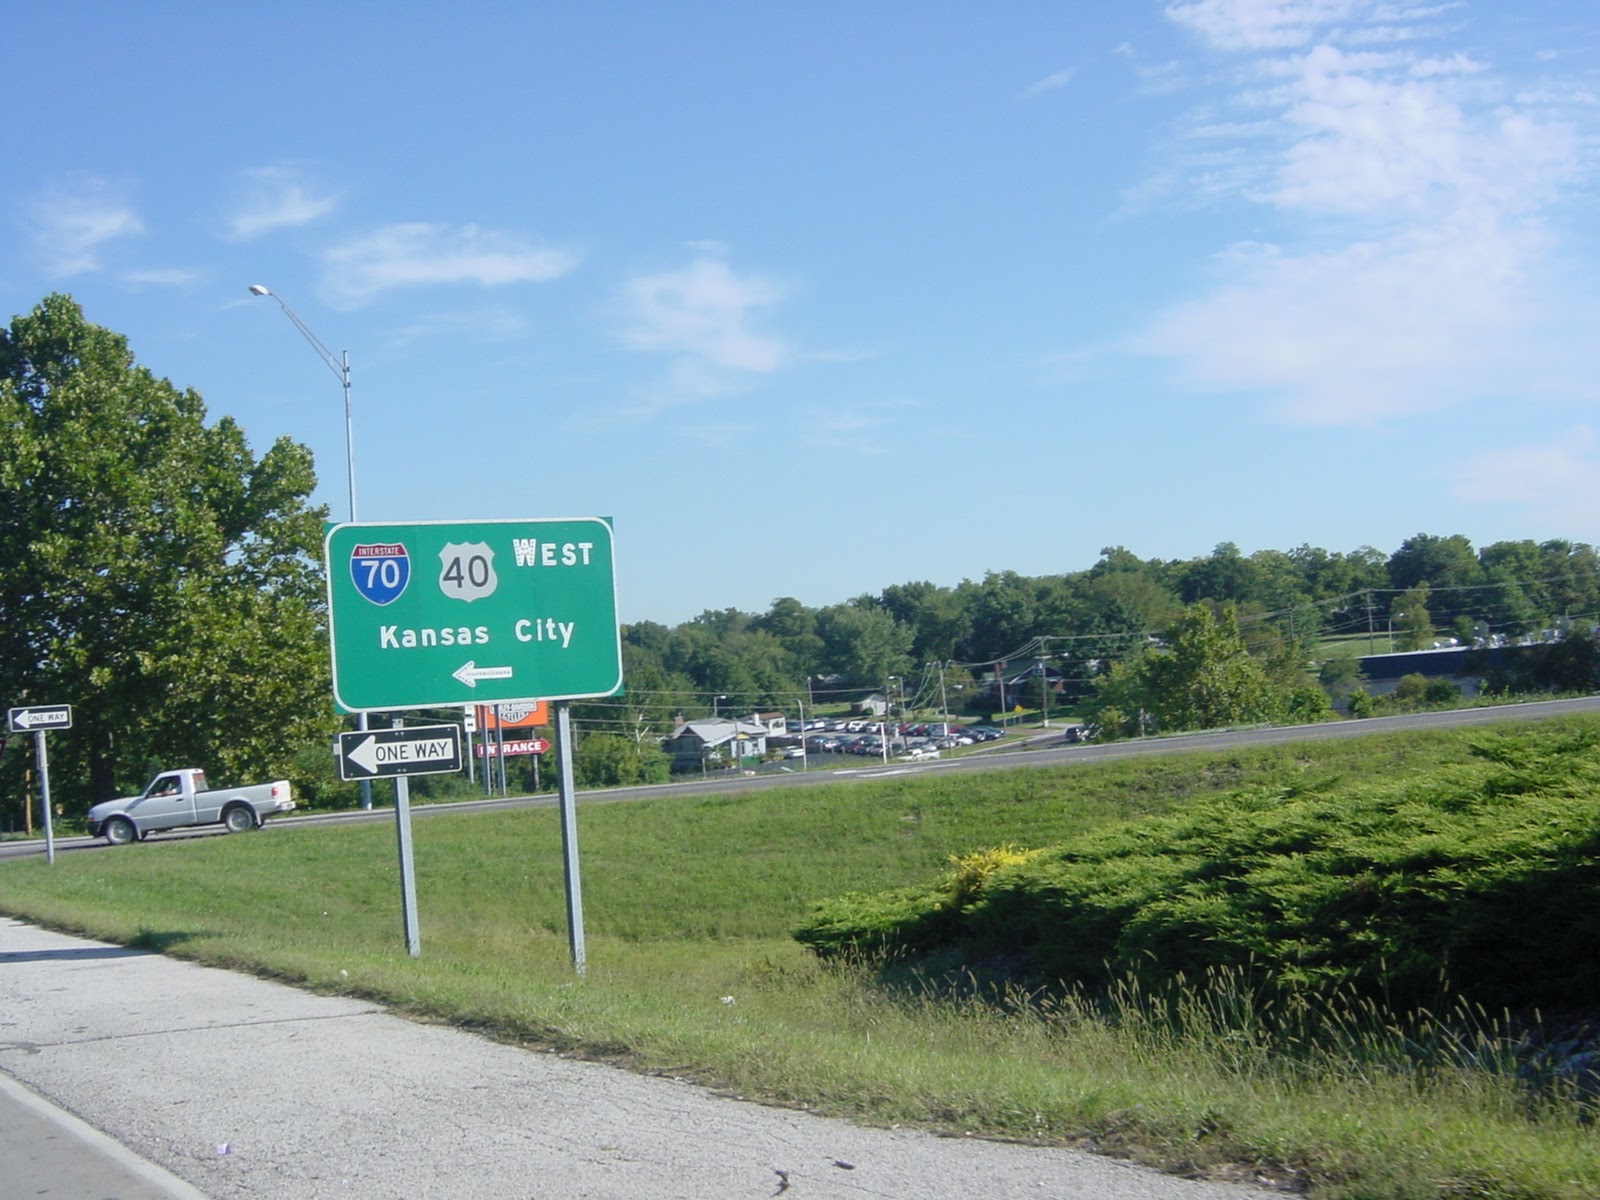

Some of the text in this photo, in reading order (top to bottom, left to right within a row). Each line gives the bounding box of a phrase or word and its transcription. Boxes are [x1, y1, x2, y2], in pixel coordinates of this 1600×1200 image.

[358, 547, 399, 556] INTERSTATE
[512, 538, 593, 566] WEST
[361, 560, 400, 588] 70
[443, 555, 489, 588] 40
[380, 617, 575, 649] Kansas City
[28, 712, 65, 722] ONE WAY
[375, 741, 449, 761] ONE WAY
